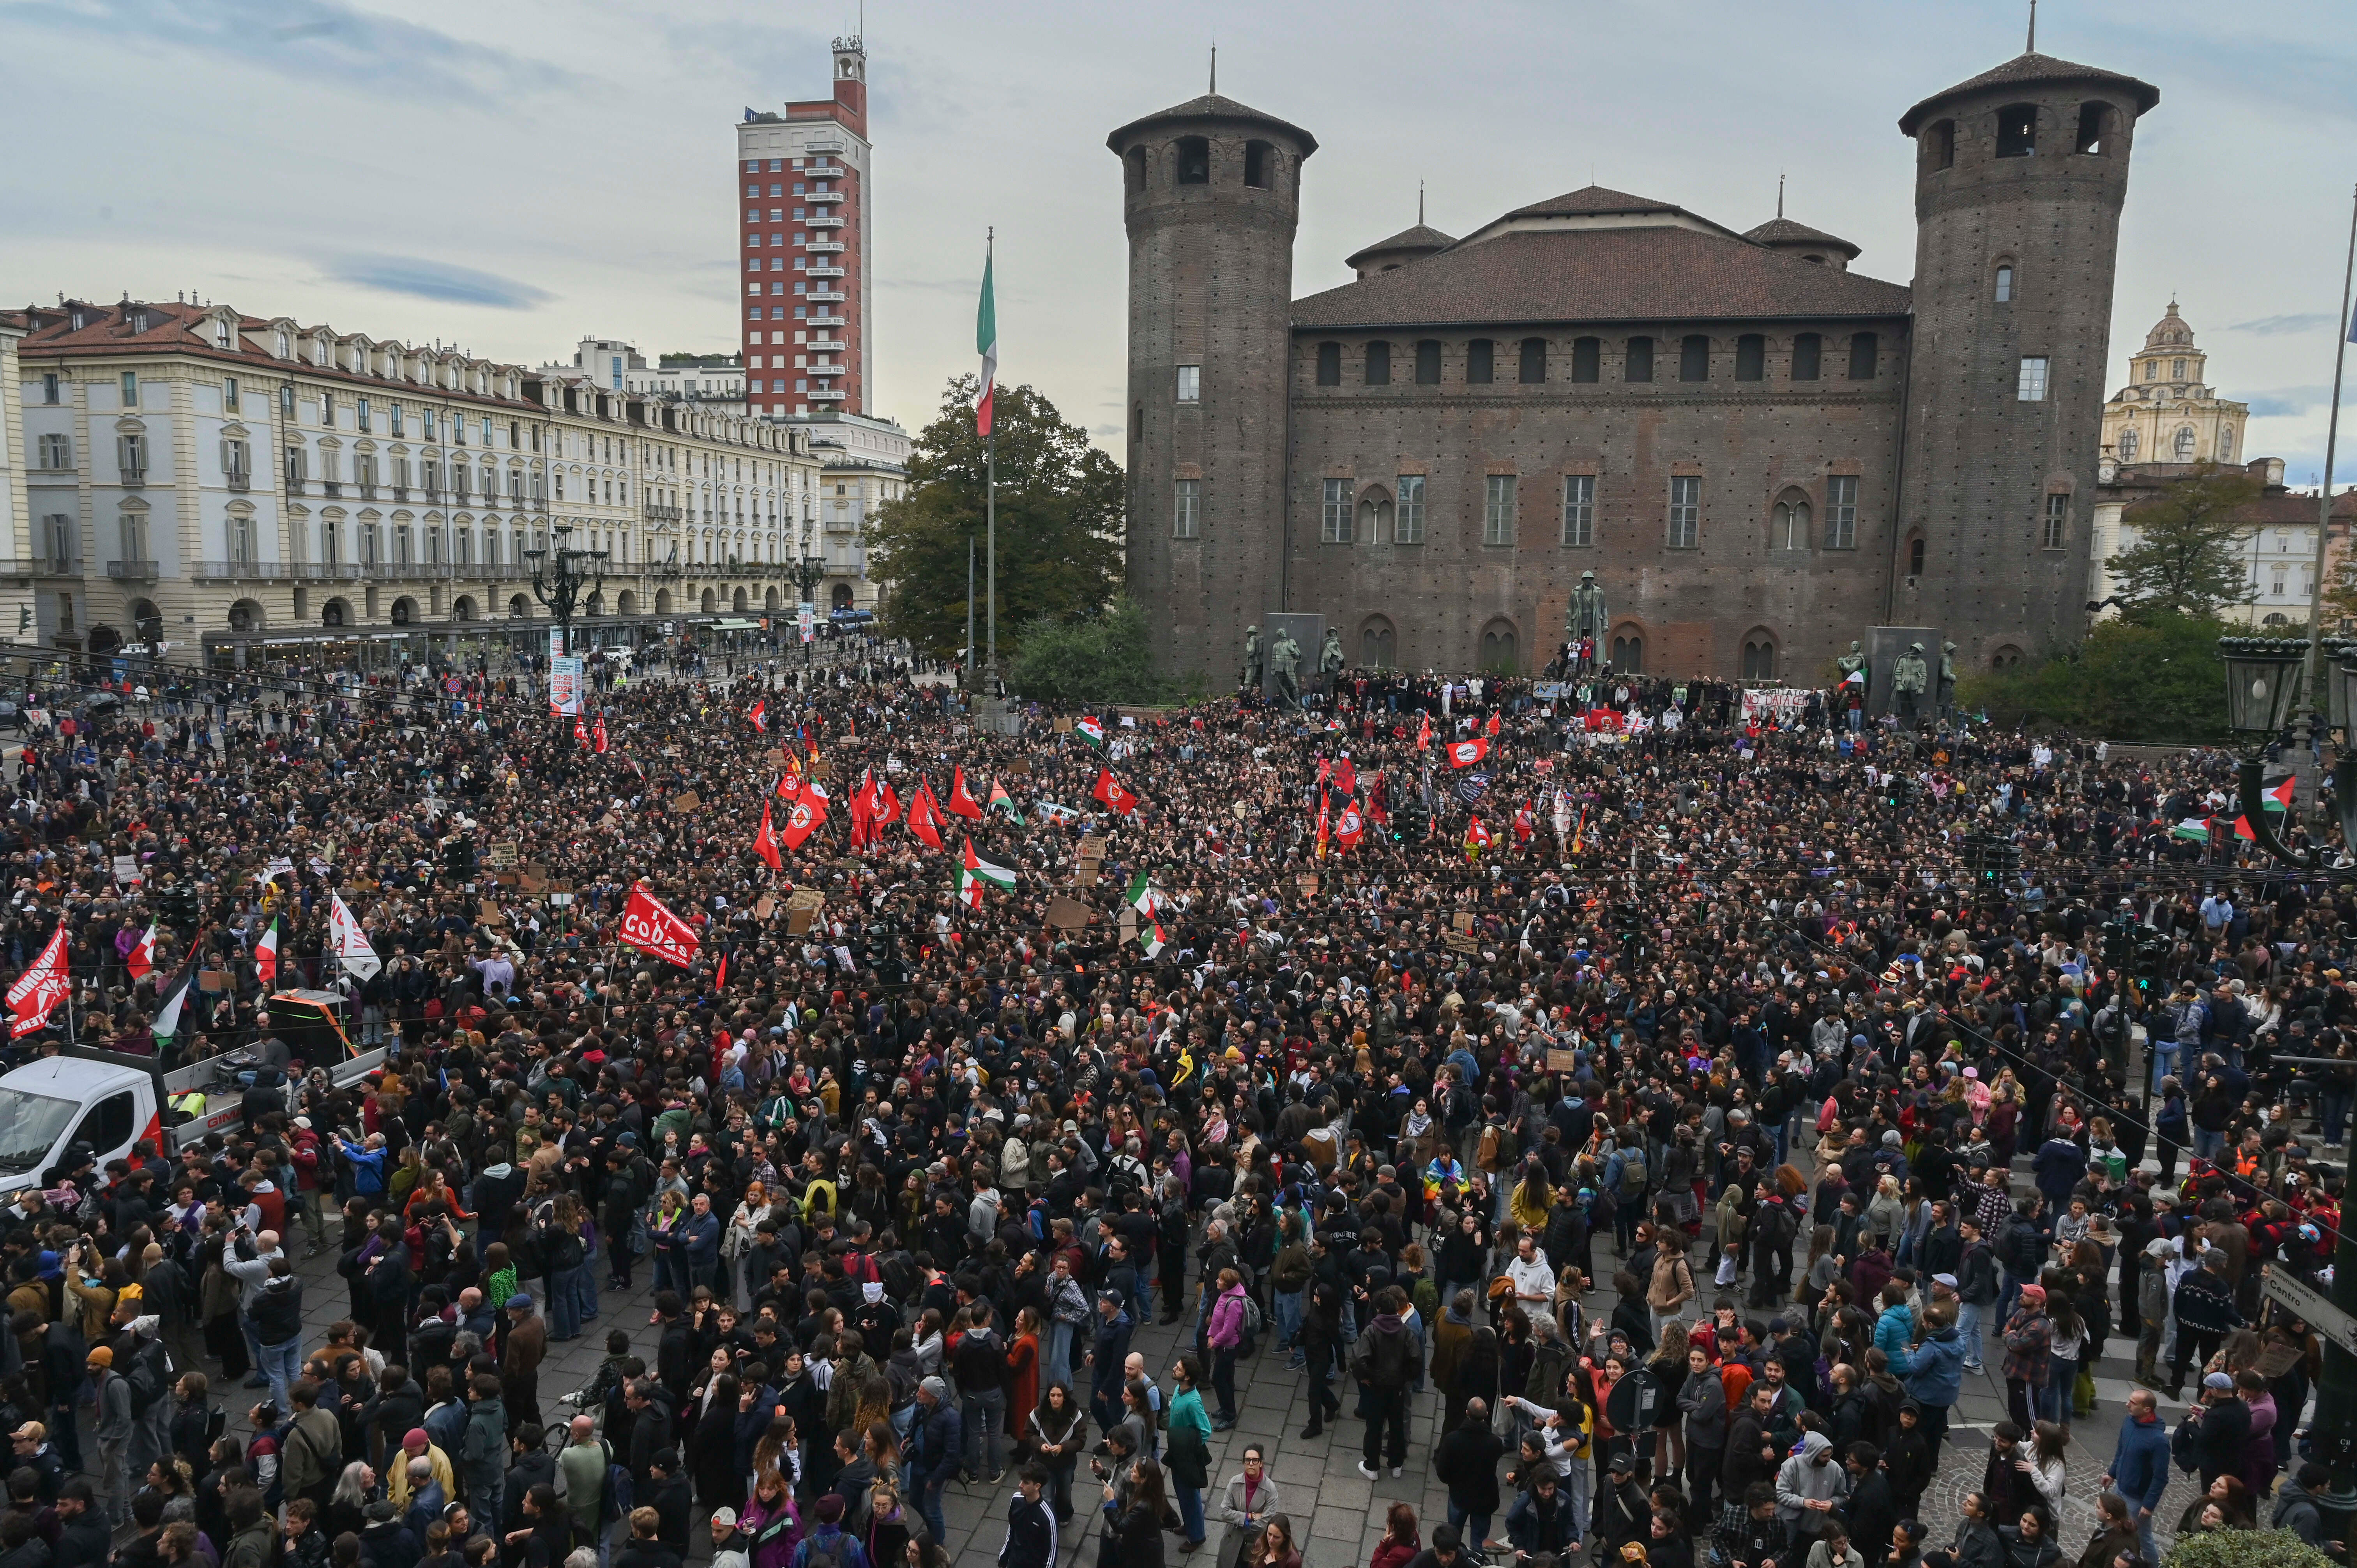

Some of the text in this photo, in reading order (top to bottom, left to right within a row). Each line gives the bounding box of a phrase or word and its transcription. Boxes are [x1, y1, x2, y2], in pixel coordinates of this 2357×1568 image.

[1744, 694, 1809, 706] NO DATA CEN
[32, 711, 40, 721] R
[636, 885, 661, 909] Sindacato
[620, 933, 688, 965] avoratori Autorganizza
[2270, 1280, 2300, 1307] Centro
[2272, 1270, 2316, 1303] commissariato
[2325, 1328, 2337, 1340] Verdi
